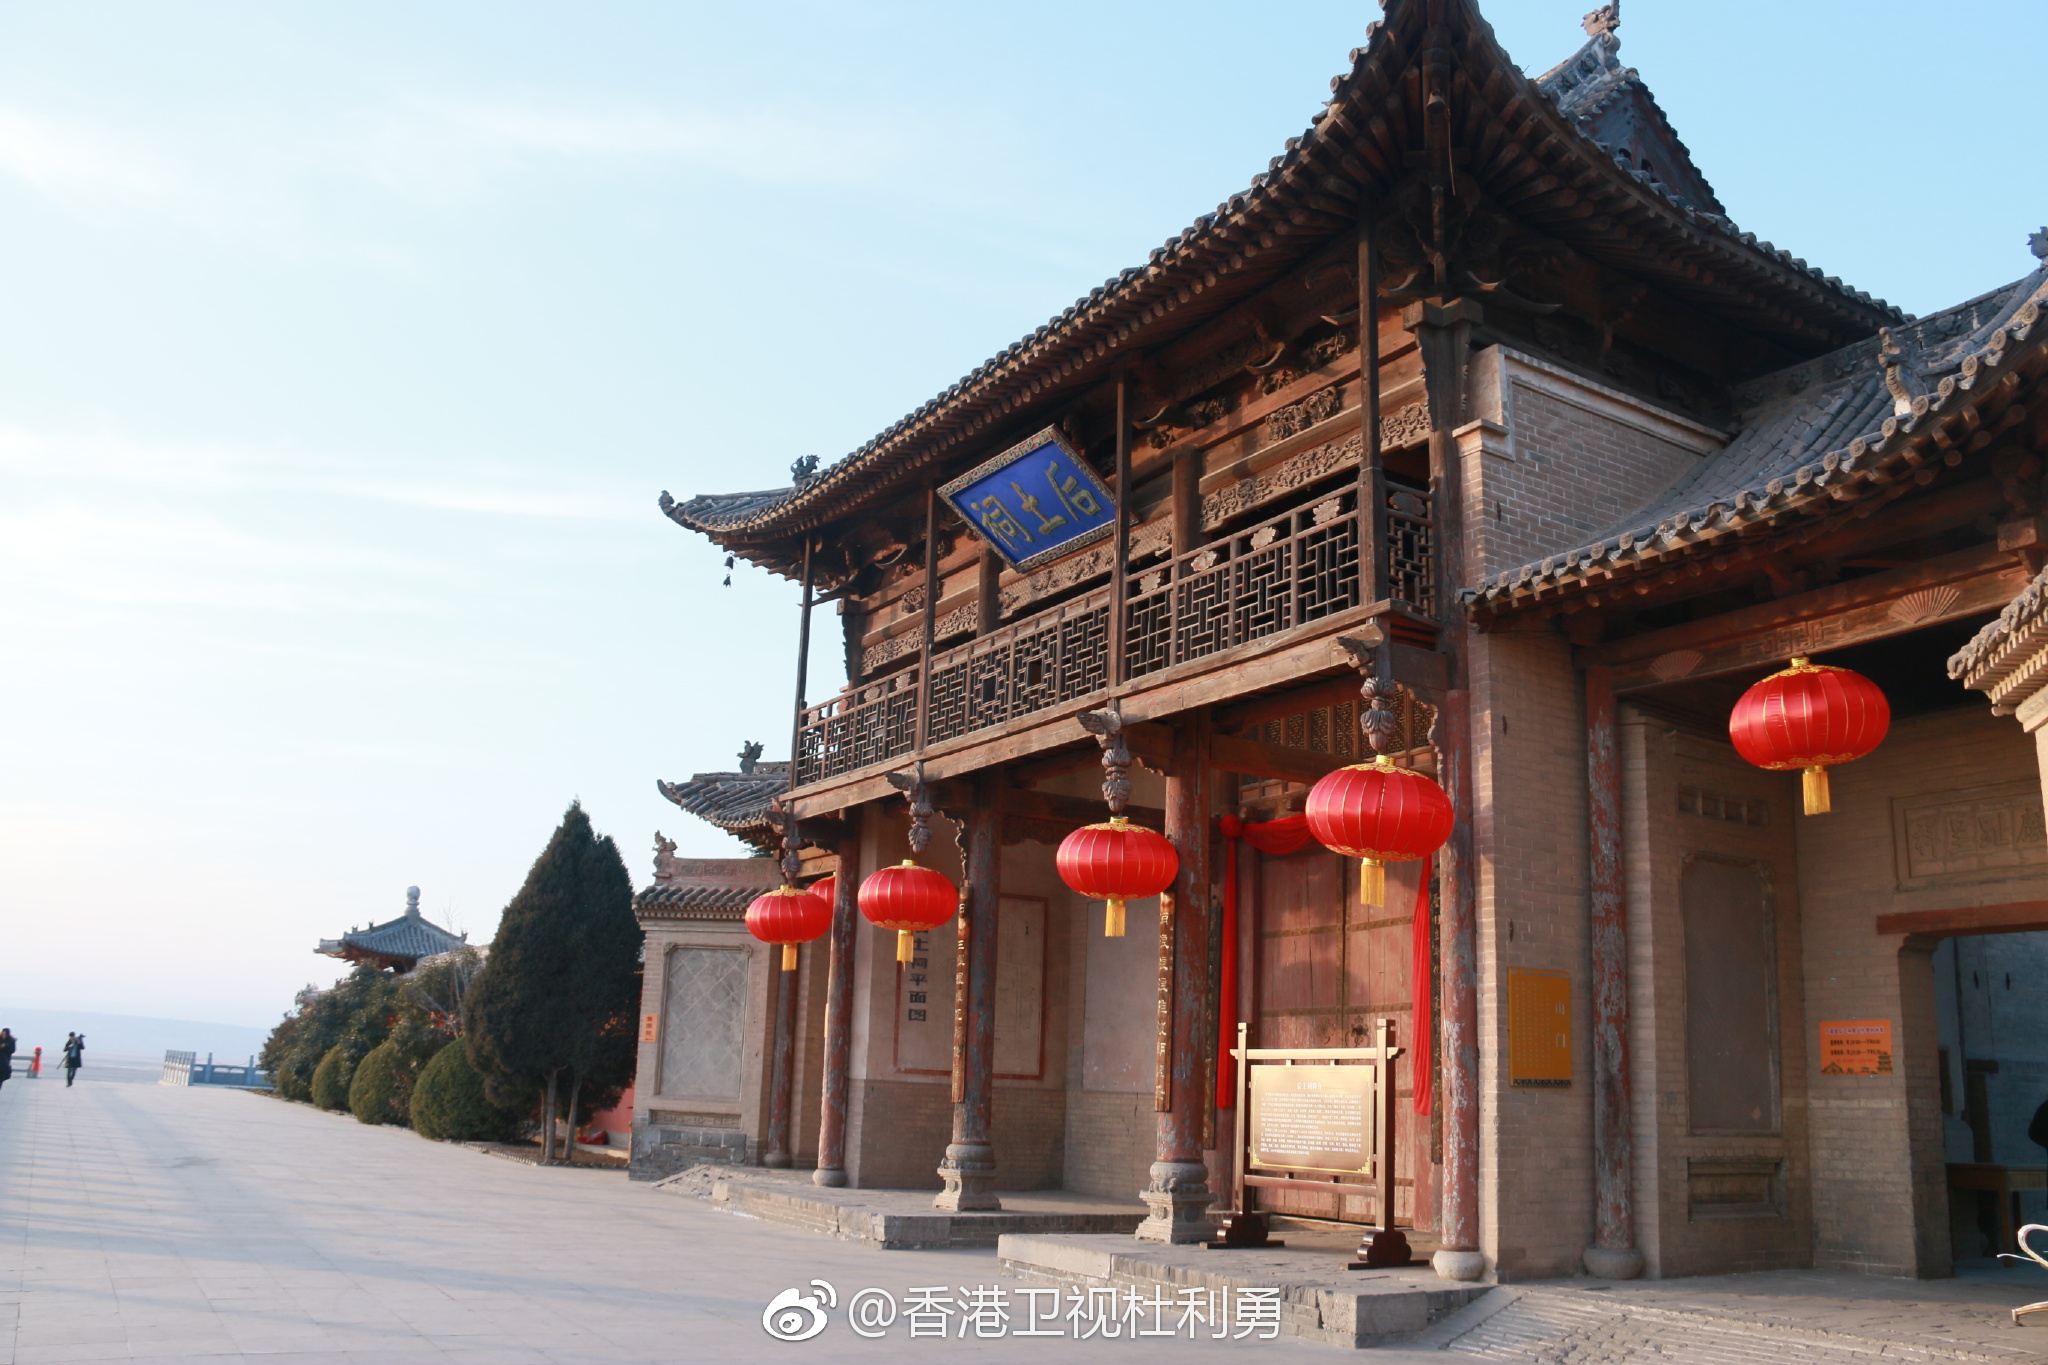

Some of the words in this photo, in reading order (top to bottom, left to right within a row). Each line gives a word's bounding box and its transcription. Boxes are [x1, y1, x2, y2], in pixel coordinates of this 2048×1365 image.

[970, 460, 1102, 552] 后土祠
[908, 930, 929, 1022] 土祠平面图
